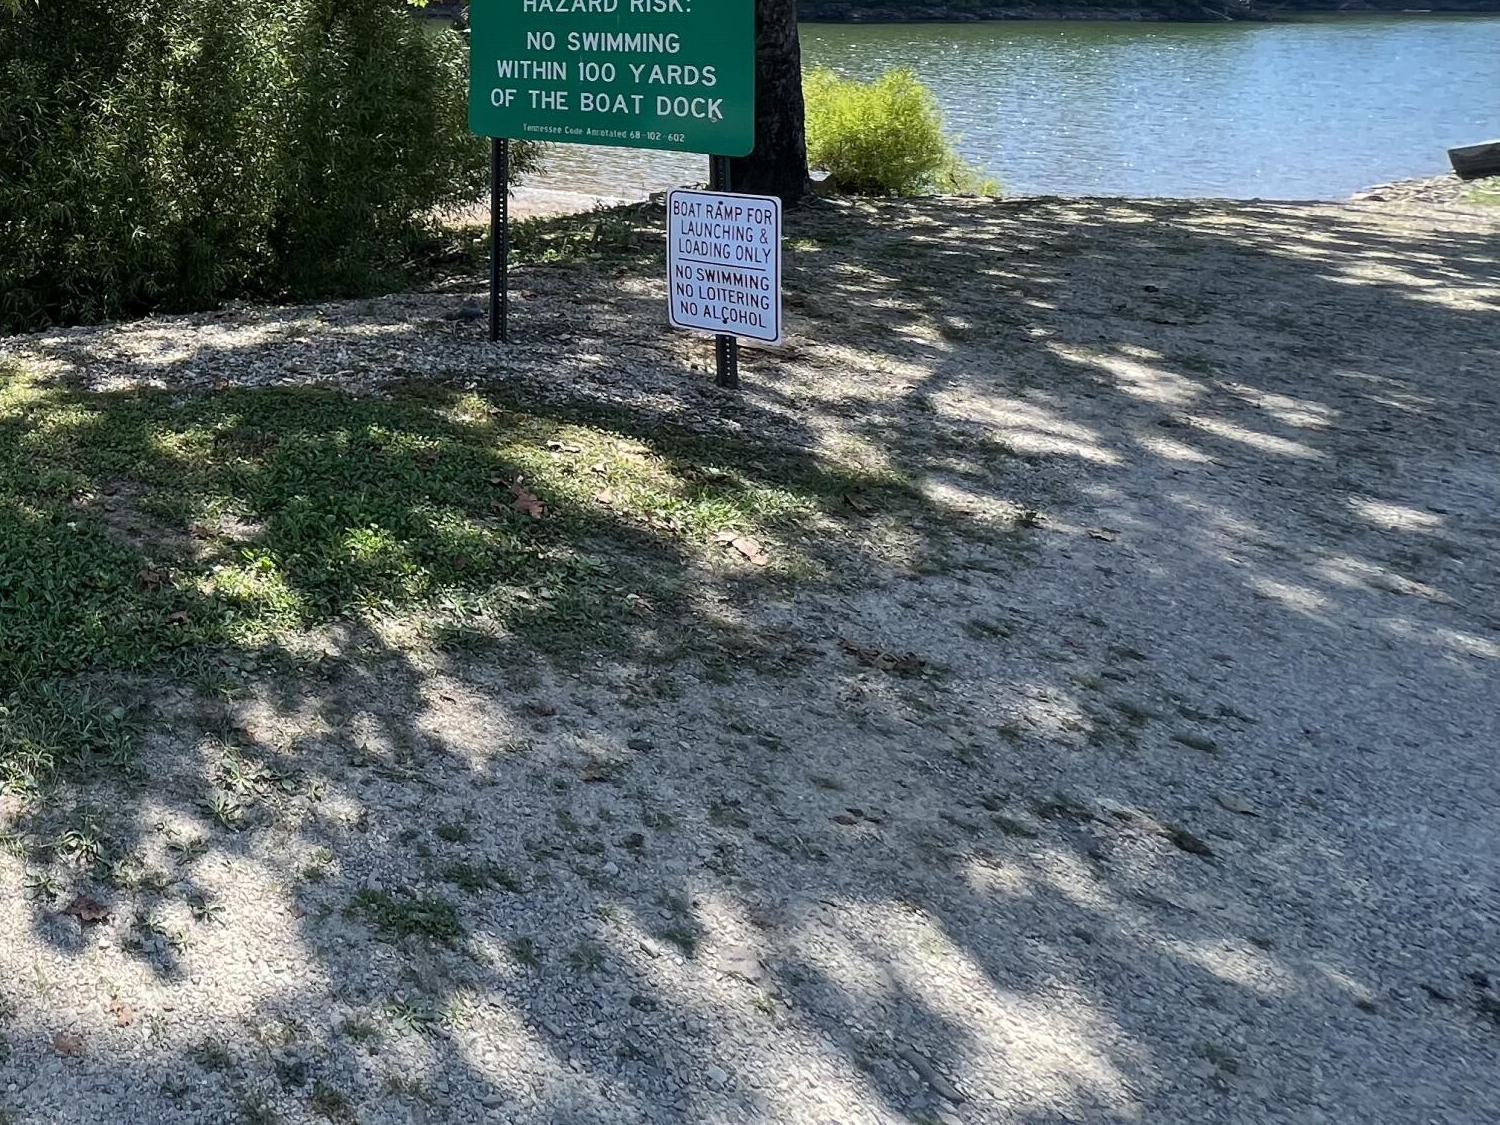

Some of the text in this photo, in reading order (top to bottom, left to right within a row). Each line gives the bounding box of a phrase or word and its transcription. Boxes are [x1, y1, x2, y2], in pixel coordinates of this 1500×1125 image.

[527, 32, 680, 53] NO SWIMMING
[497, 60, 717, 87] WITHIN 100 YARDS
[491, 88, 723, 120] OF THE BOAT DOCK
[523, 123, 562, 134] Tennessee
[564, 125, 583, 136] Code
[586, 127, 627, 139] Annotated
[674, 201, 772, 225] BOAT RAMP FOR
[681, 220, 768, 244] LAUNCHING &
[679, 238, 771, 264] LOADING ONLY
[676, 264, 769, 291] NO SWIMMING
[676, 282, 769, 310] NO LOITERING
[681, 301, 767, 328] NO ALCOHOL
